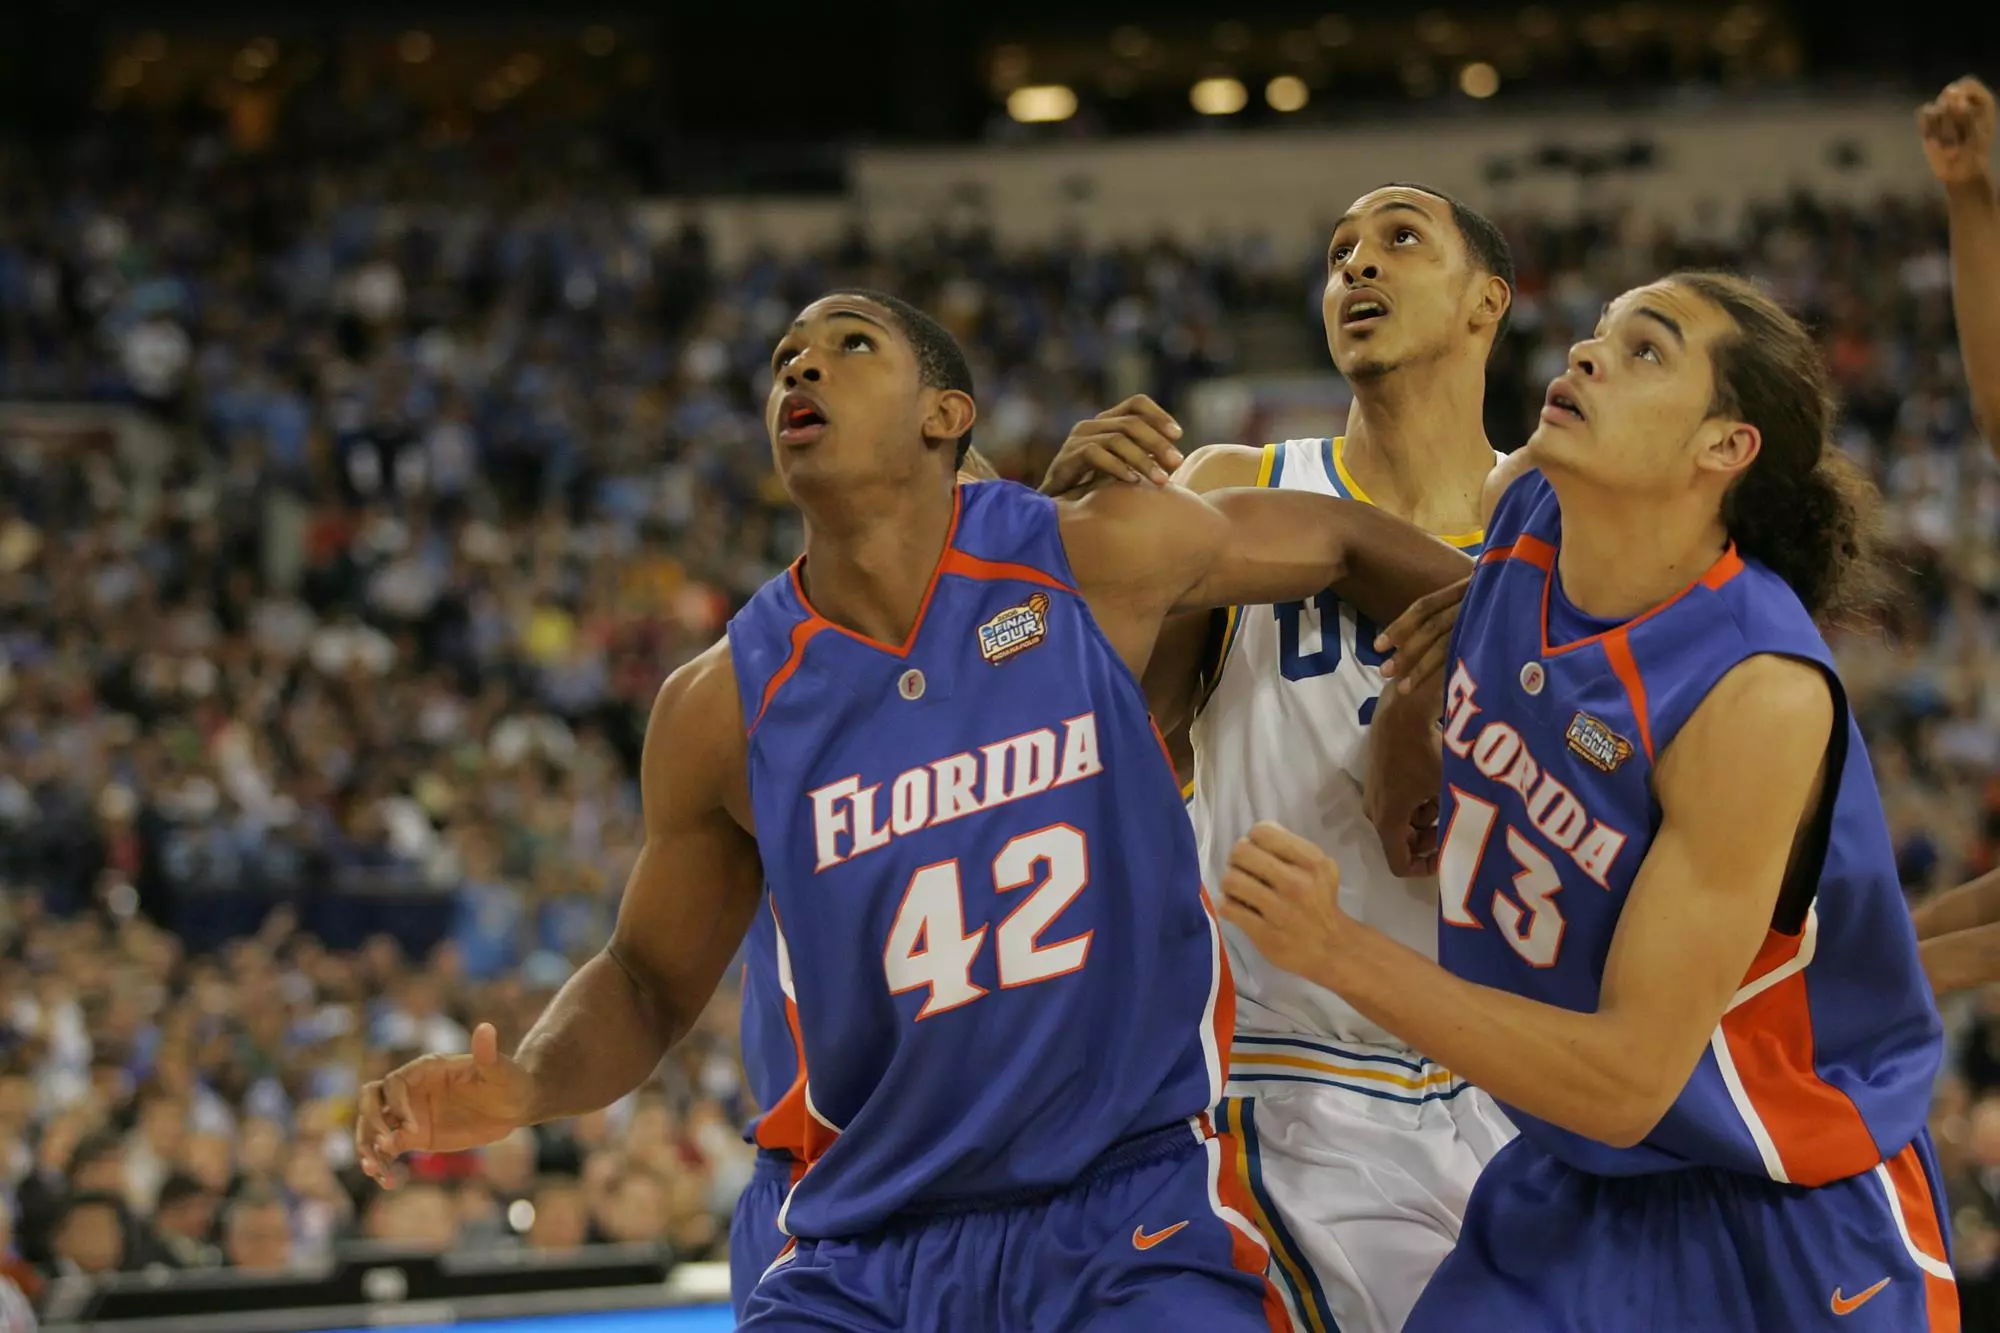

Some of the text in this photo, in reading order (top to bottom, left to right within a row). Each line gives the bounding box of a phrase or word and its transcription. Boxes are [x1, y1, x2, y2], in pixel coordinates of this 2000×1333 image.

[984, 620, 1038, 651] FOUR
[995, 610, 1034, 635] FINAL
[1526, 671, 1540, 686] F
[1571, 726, 1614, 764] FOUR
[1585, 726, 1616, 752] FINAL
[806, 711, 1104, 874] FLORIDA
[1443, 657, 1627, 891] FLORIDA
[1438, 783, 1566, 968] 13
[883, 822, 1094, 1022] 42
